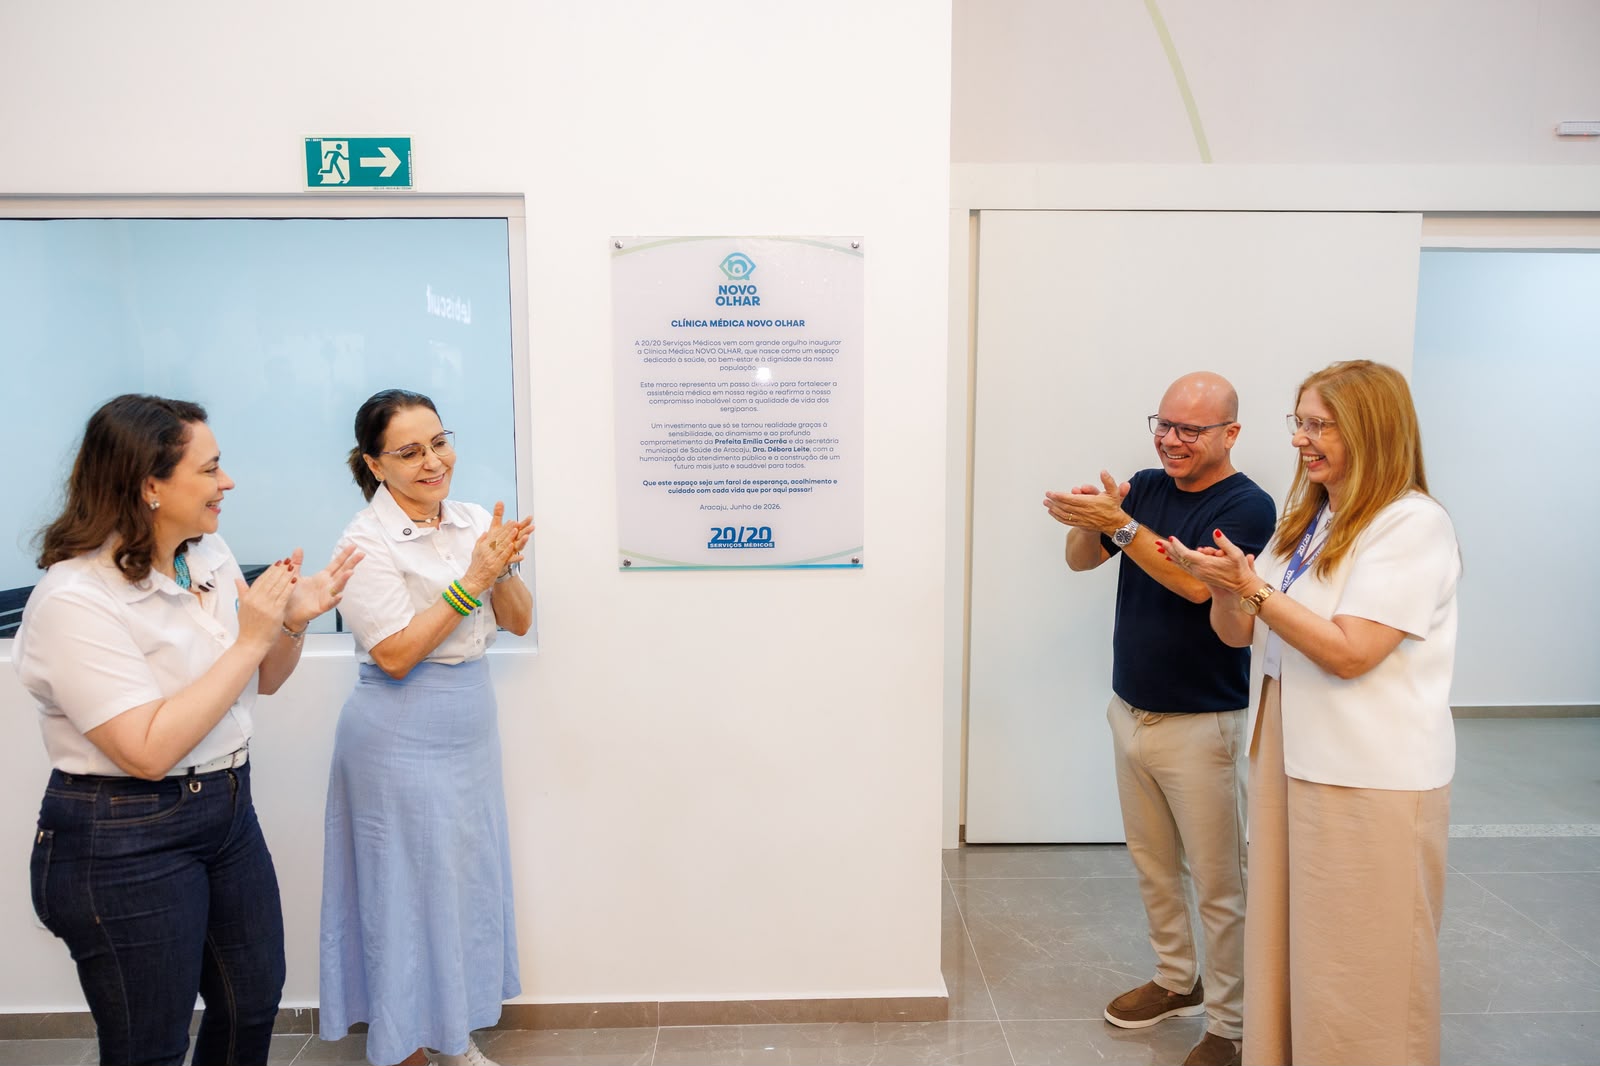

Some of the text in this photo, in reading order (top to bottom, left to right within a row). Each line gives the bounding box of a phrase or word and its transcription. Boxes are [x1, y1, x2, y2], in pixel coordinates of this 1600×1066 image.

[719, 285, 757, 295] NOVO
[716, 296, 760, 306] OLHAR
[671, 318, 708, 328] CLÍNICA
[710, 318, 745, 327] MÉDICA
[781, 339, 808, 347] orgulho
[767, 356, 802, 364] dignidade
[639, 455, 686, 463] humanização
[710, 526, 772, 542] 20/20
[1297, 533, 1312, 557] 20/20
